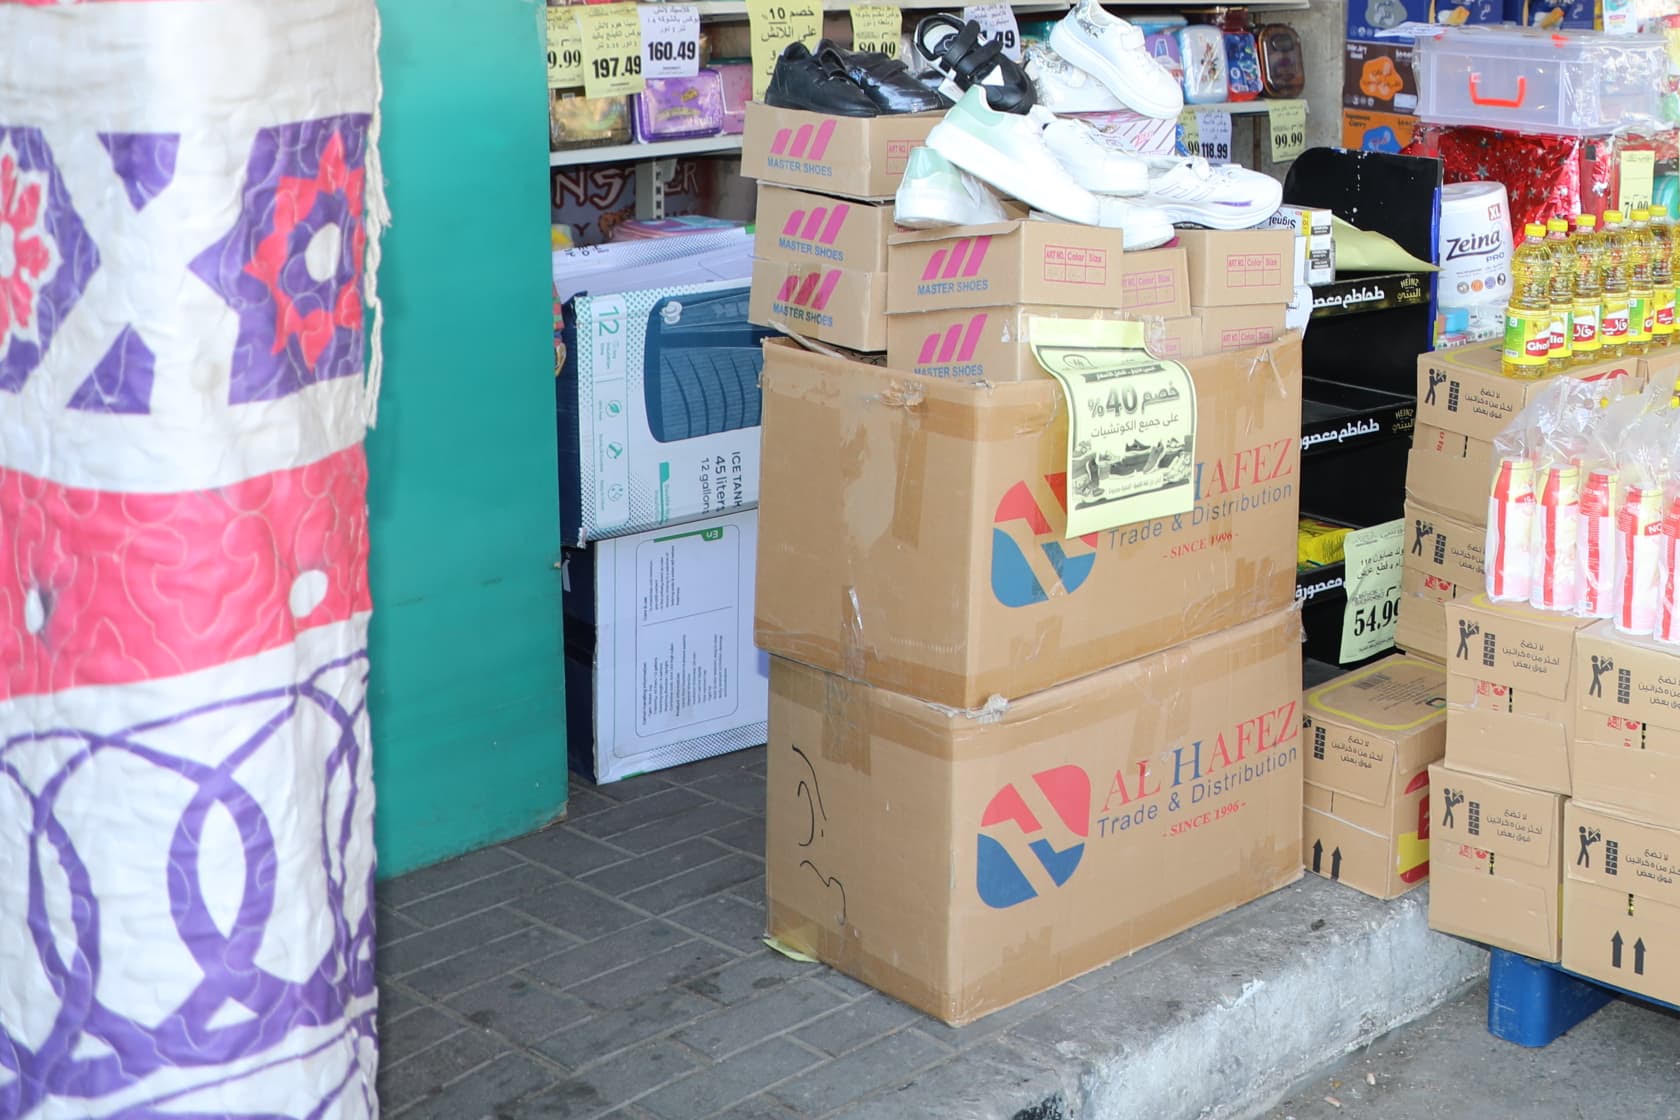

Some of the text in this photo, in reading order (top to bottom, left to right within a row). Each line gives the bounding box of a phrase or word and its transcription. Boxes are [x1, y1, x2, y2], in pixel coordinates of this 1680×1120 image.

[648, 40, 696, 62] 160.49
[592, 55, 641, 79] 197.49
[1274, 131, 1303, 149] 99.99
[1201, 141, 1228, 159] 118.99
[767, 157, 832, 177] MASTER SHOES
[1488, 204, 1502, 220] XL
[1269, 216, 1297, 230] Signal
[779, 237, 844, 262] MASTER SHOES
[1446, 230, 1502, 262] Zeina
[1486, 251, 1505, 263] PRO
[917, 279, 989, 296] MASTER SHOES
[1400, 277, 1420, 289] HEINZ
[773, 303, 833, 327] MASTER SHOES
[1140, 382, 1180, 411] خصم
[1162, 412, 1180, 427] على
[1395, 408, 1414, 420] HEINZ
[1138, 417, 1162, 433] جميع
[1302, 430, 1340, 451] معصو
[700, 457, 710, 472] 12
[715, 455, 726, 475] 45
[731, 451, 742, 473] ICE
[1109, 484, 1293, 551] Trade & Distribution
[1169, 530, 1234, 560] SINCE 1996
[1502, 646, 1526, 660] كراتين
[1546, 657, 1560, 666] أكثر
[1638, 681, 1665, 695] كراتين
[1101, 700, 1299, 813] AL HAFEZ
[1097, 746, 1298, 839] Trade & Distribution
[1169, 799, 1241, 838] SINCE 1996
[1486, 815, 1509, 828] كراتين
[1527, 826, 1543, 835] أكثر
[1625, 854, 1649, 869] كراتين
